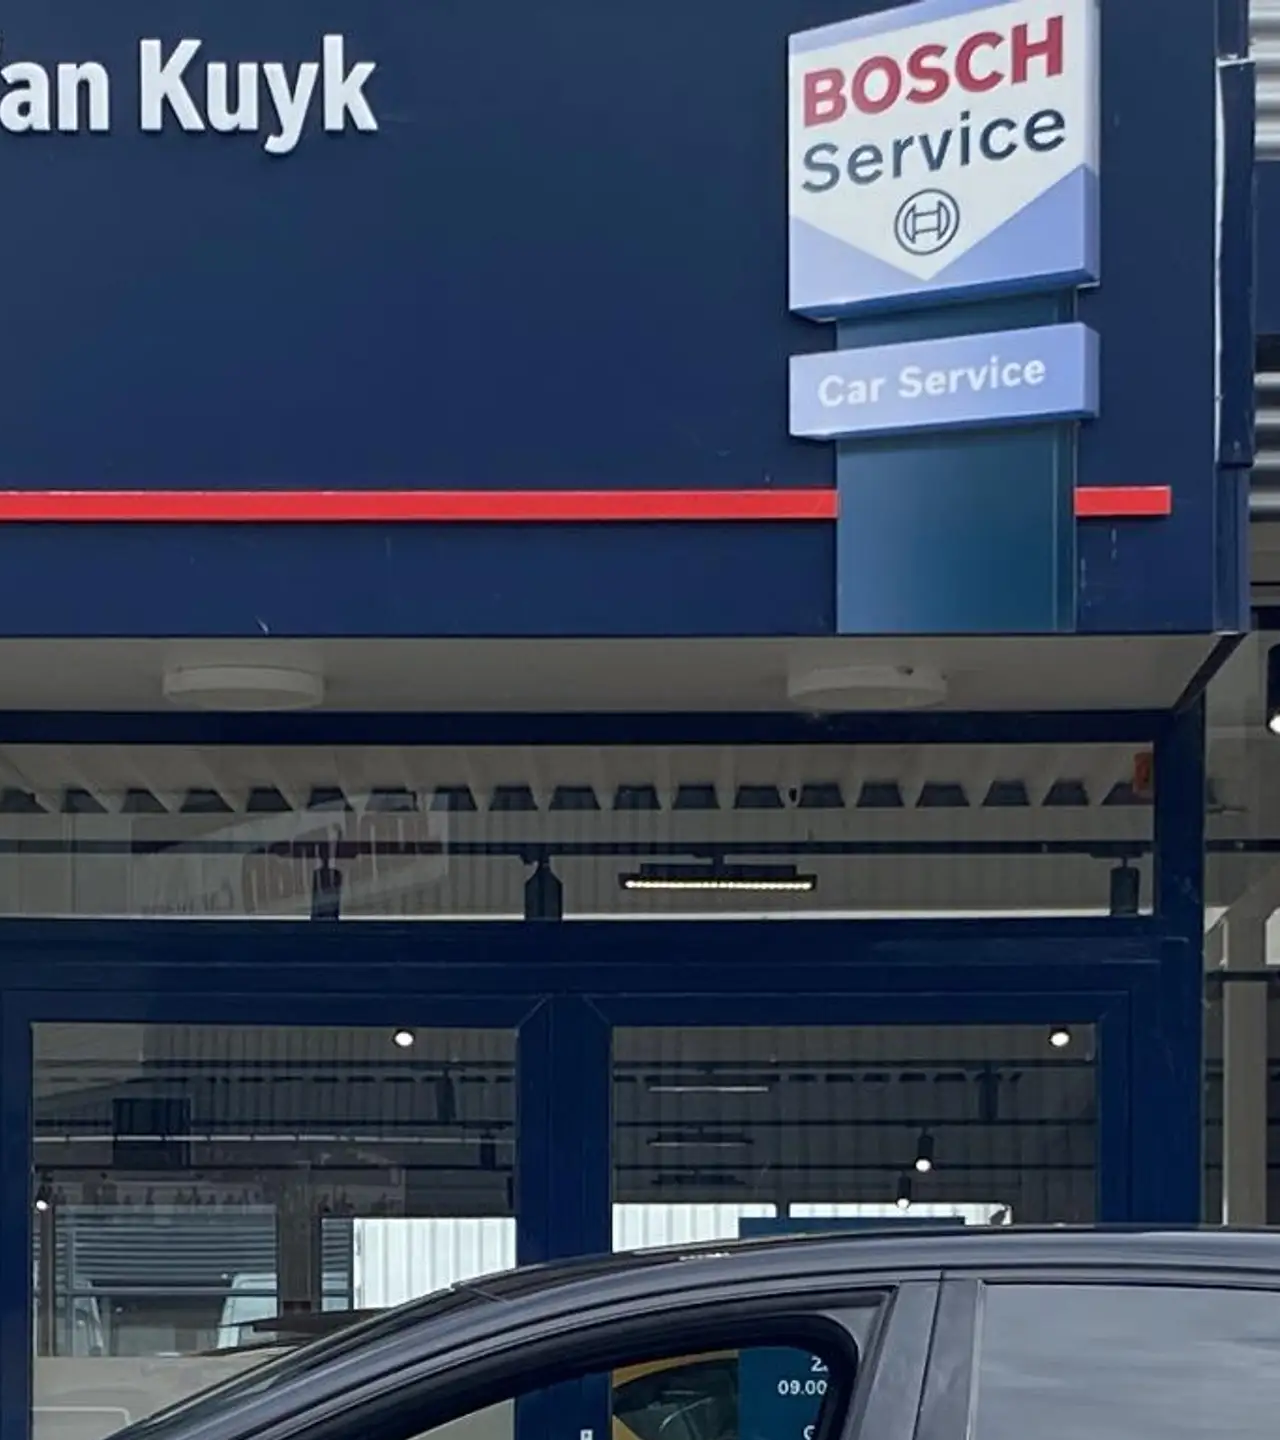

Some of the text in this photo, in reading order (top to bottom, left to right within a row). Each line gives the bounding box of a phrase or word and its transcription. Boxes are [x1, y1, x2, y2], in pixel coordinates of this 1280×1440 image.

[139, 34, 380, 155] Kuyk
[803, 14, 1064, 128] BOSCH
[801, 108, 1066, 194] Service
[817, 355, 1047, 409] Car Service
